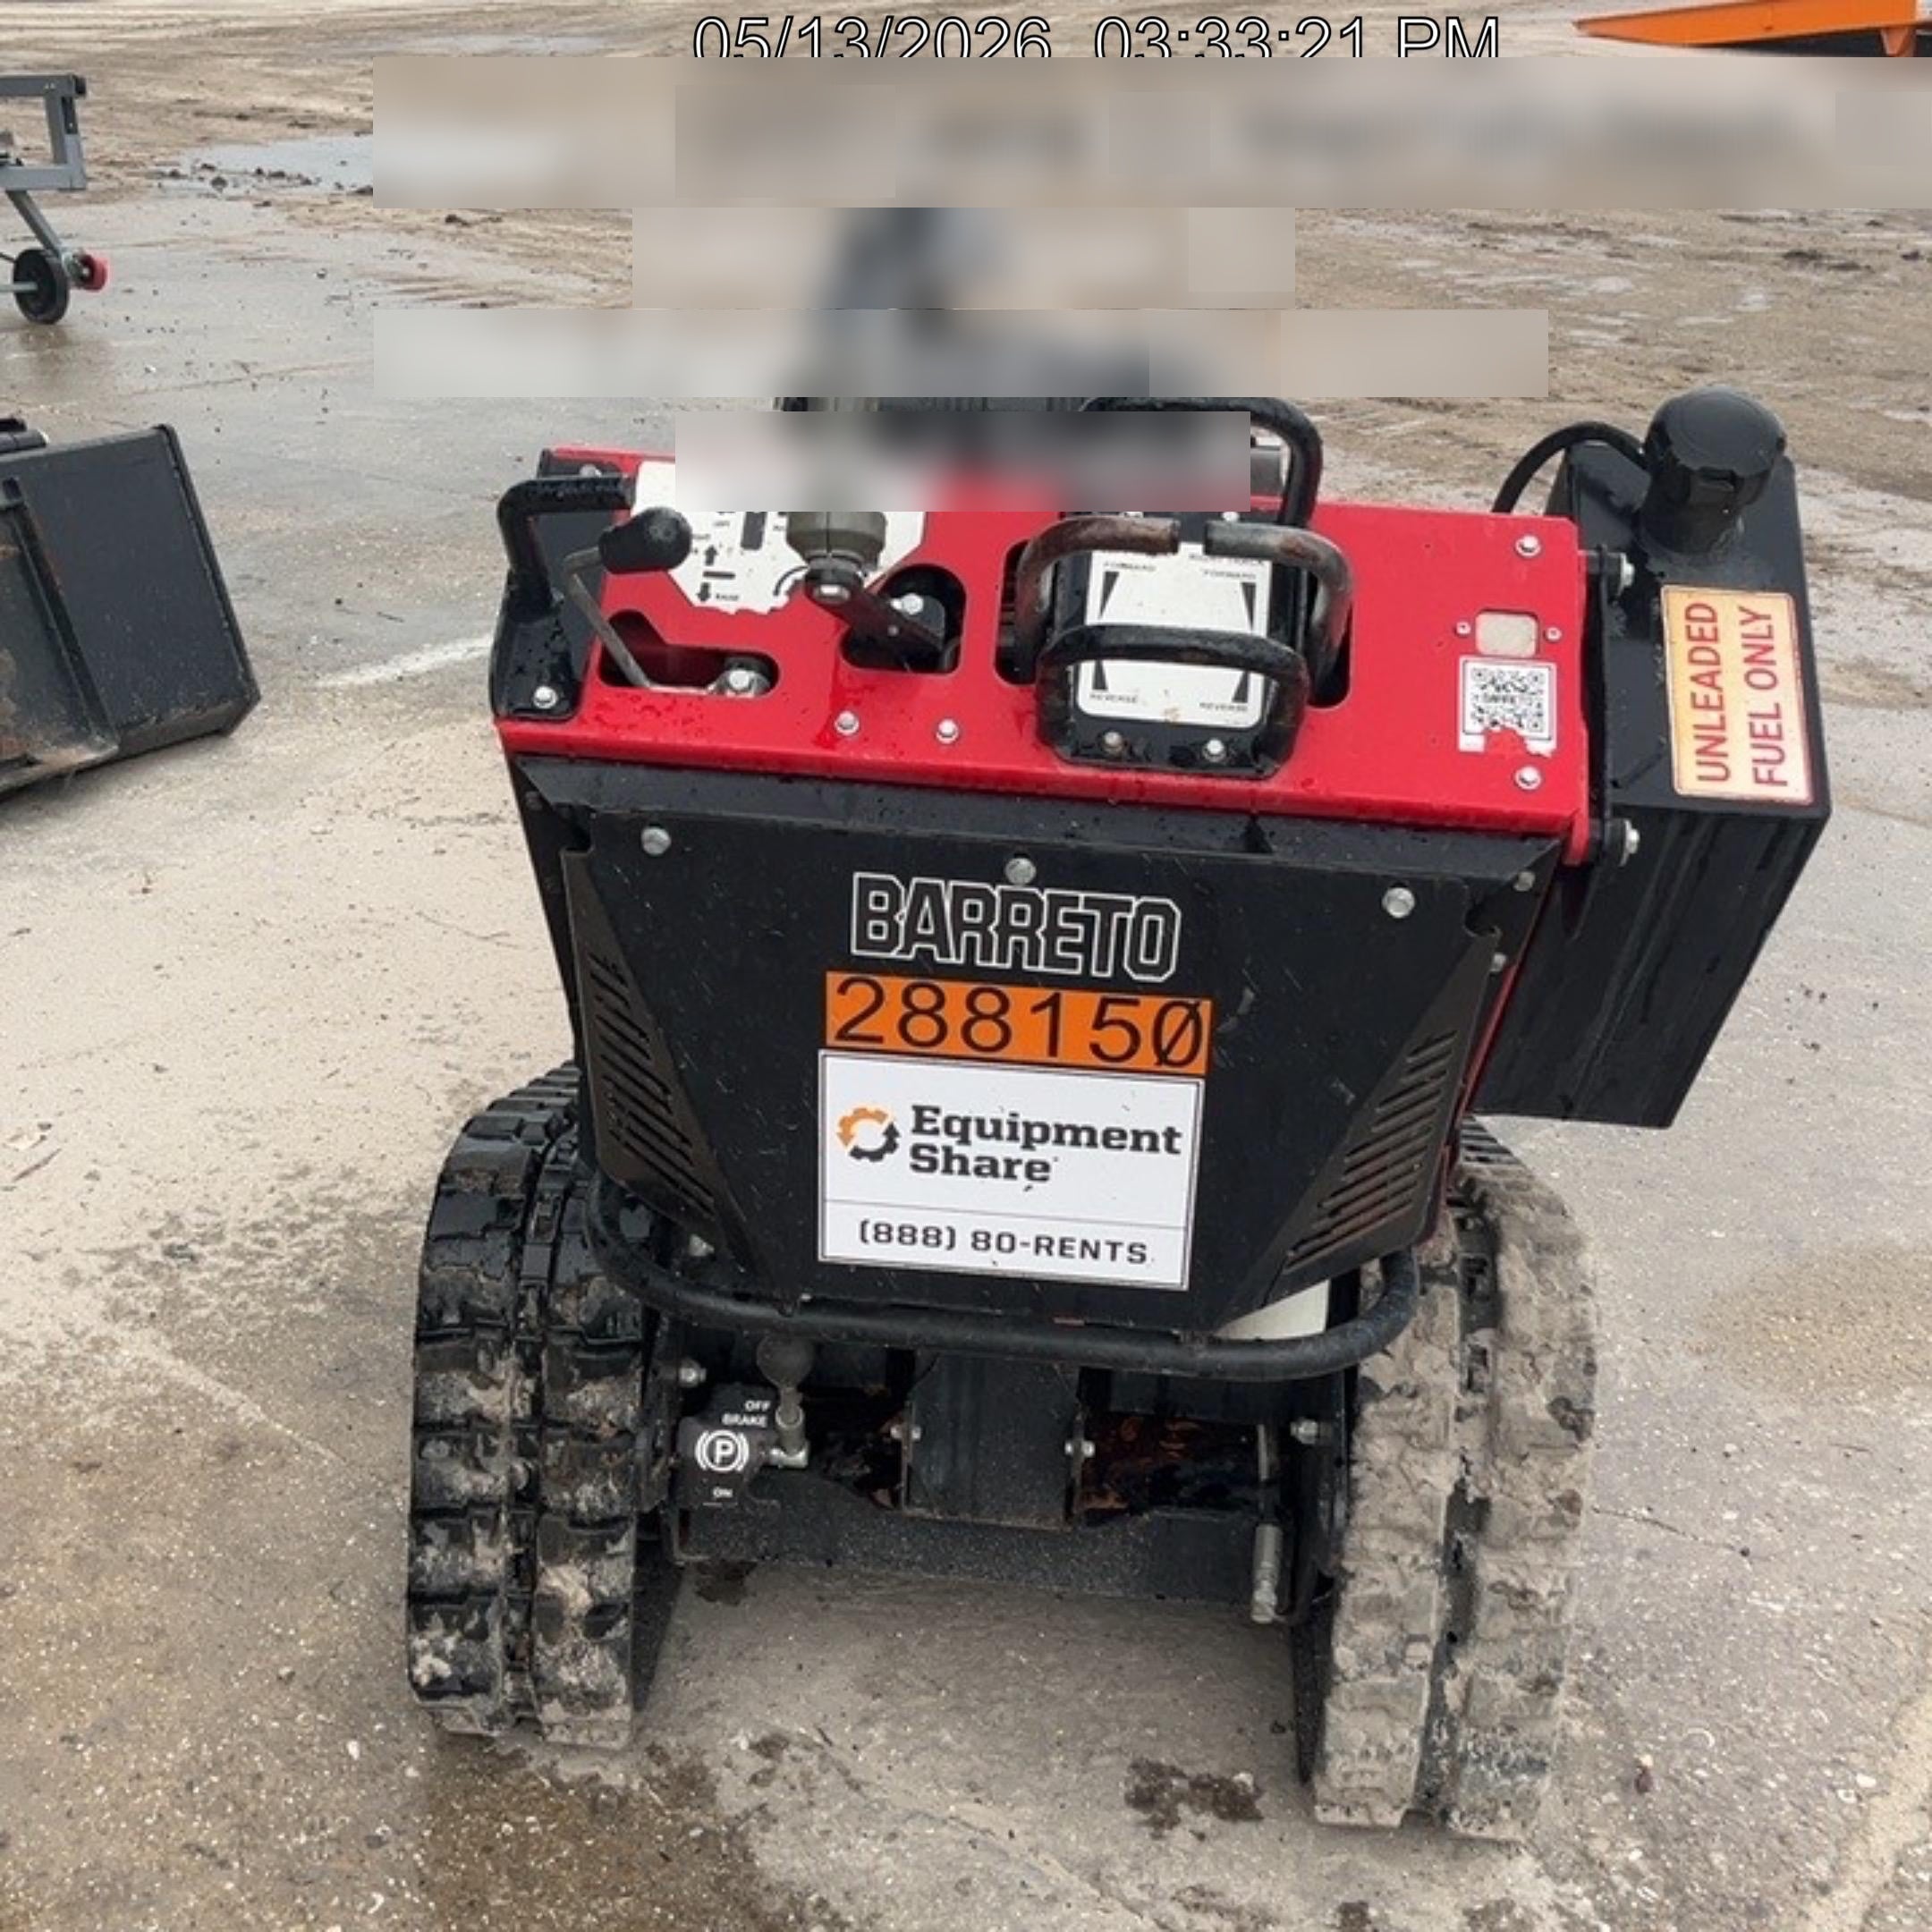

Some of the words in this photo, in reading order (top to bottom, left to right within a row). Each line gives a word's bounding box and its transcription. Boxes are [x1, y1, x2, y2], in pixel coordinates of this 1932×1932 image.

[1739, 606, 1778, 691] ONLY
[1685, 602, 1732, 783] UNLEADED
[1748, 702, 1788, 787] FUEL
[852, 871, 1182, 982] BARRETO
[834, 976, 1204, 1067] 288150
[911, 1105, 1182, 1155] Equipment
[909, 1143, 1051, 1182] Share
[860, 1218, 957, 1250] (888)
[970, 1231, 1148, 1266] 80-RENTS
[721, 1413, 767, 1428] BRAKE
[744, 1400, 771, 1411] OFF
[716, 1438, 734, 1465] P
[713, 1487, 733, 1497] ON
